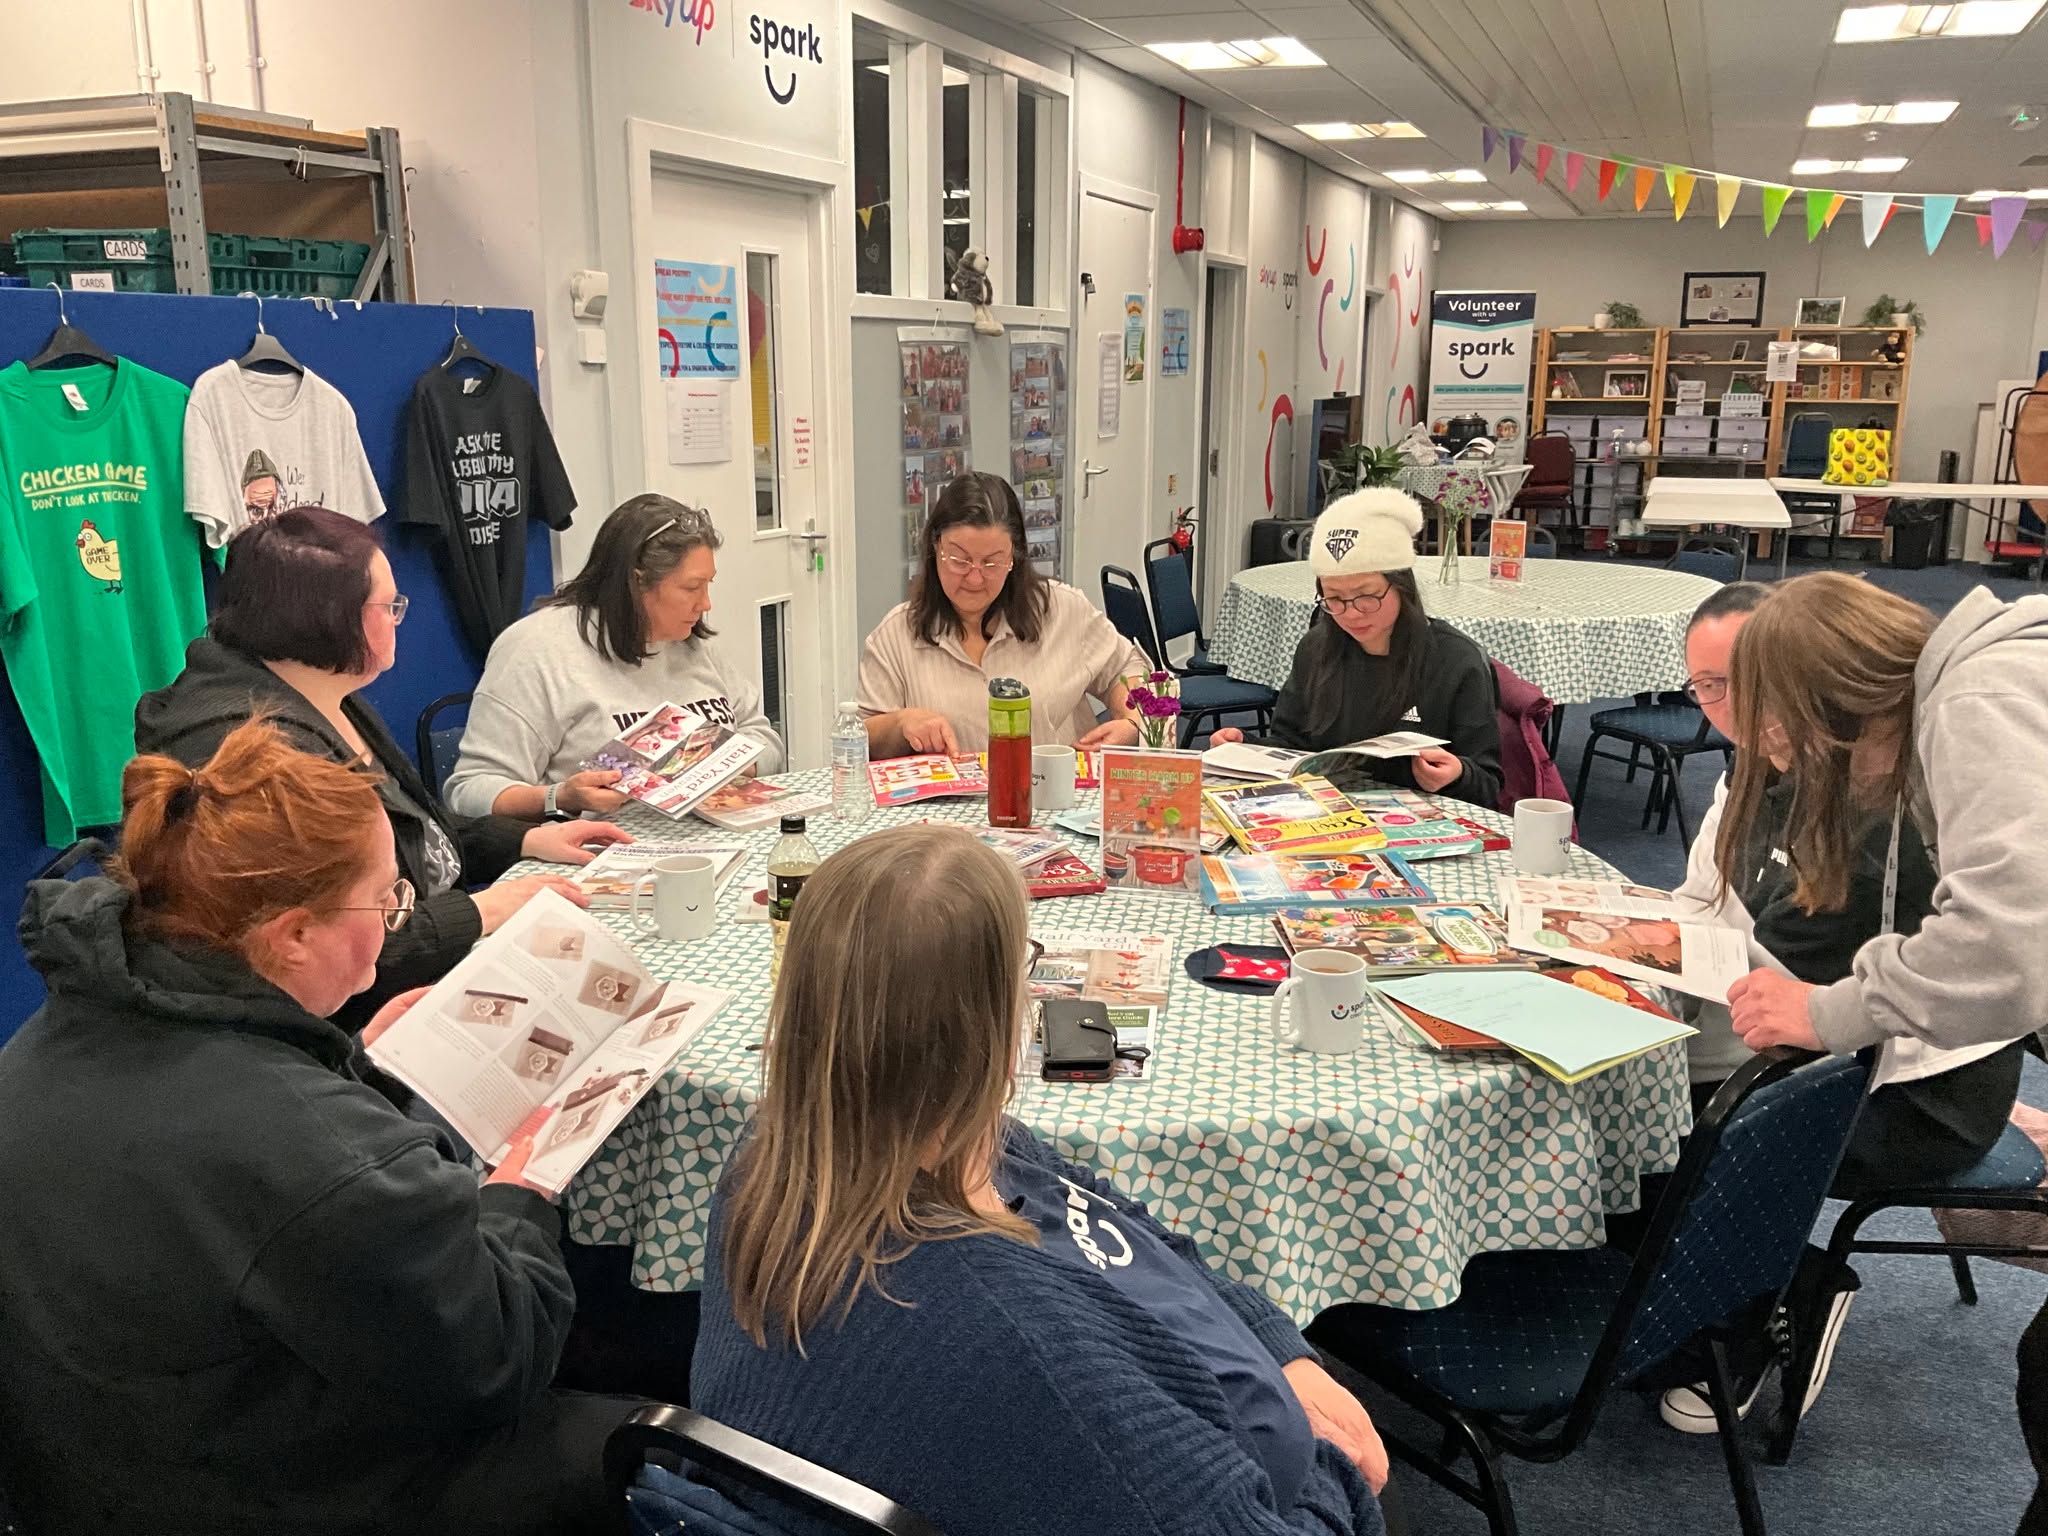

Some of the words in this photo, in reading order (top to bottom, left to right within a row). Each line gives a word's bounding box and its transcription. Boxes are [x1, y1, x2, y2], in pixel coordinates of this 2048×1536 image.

[629, 0, 714, 46] yup
[750, 14, 823, 64] spark
[105, 241, 146, 257] CARDS
[80, 278, 105, 288] CARDS
[1448, 300, 1521, 311] Volunteer
[1448, 337, 1515, 361] spark
[455, 434, 484, 455] ASK
[20, 463, 100, 492] CHICKEN
[31, 495, 62, 511] DON'T
[88, 492, 99, 504] AT
[1326, 528, 1359, 539] SUPER
[85, 547, 109, 556] GAME
[86, 555, 110, 565] OVER
[721, 743, 753, 770] Half
[687, 768, 721, 795] Yard
[1110, 767, 1147, 781] WINTER
[1148, 770, 1179, 783] WARM
[1180, 772, 1195, 784] UP
[1079, 934, 1128, 943] Yard
